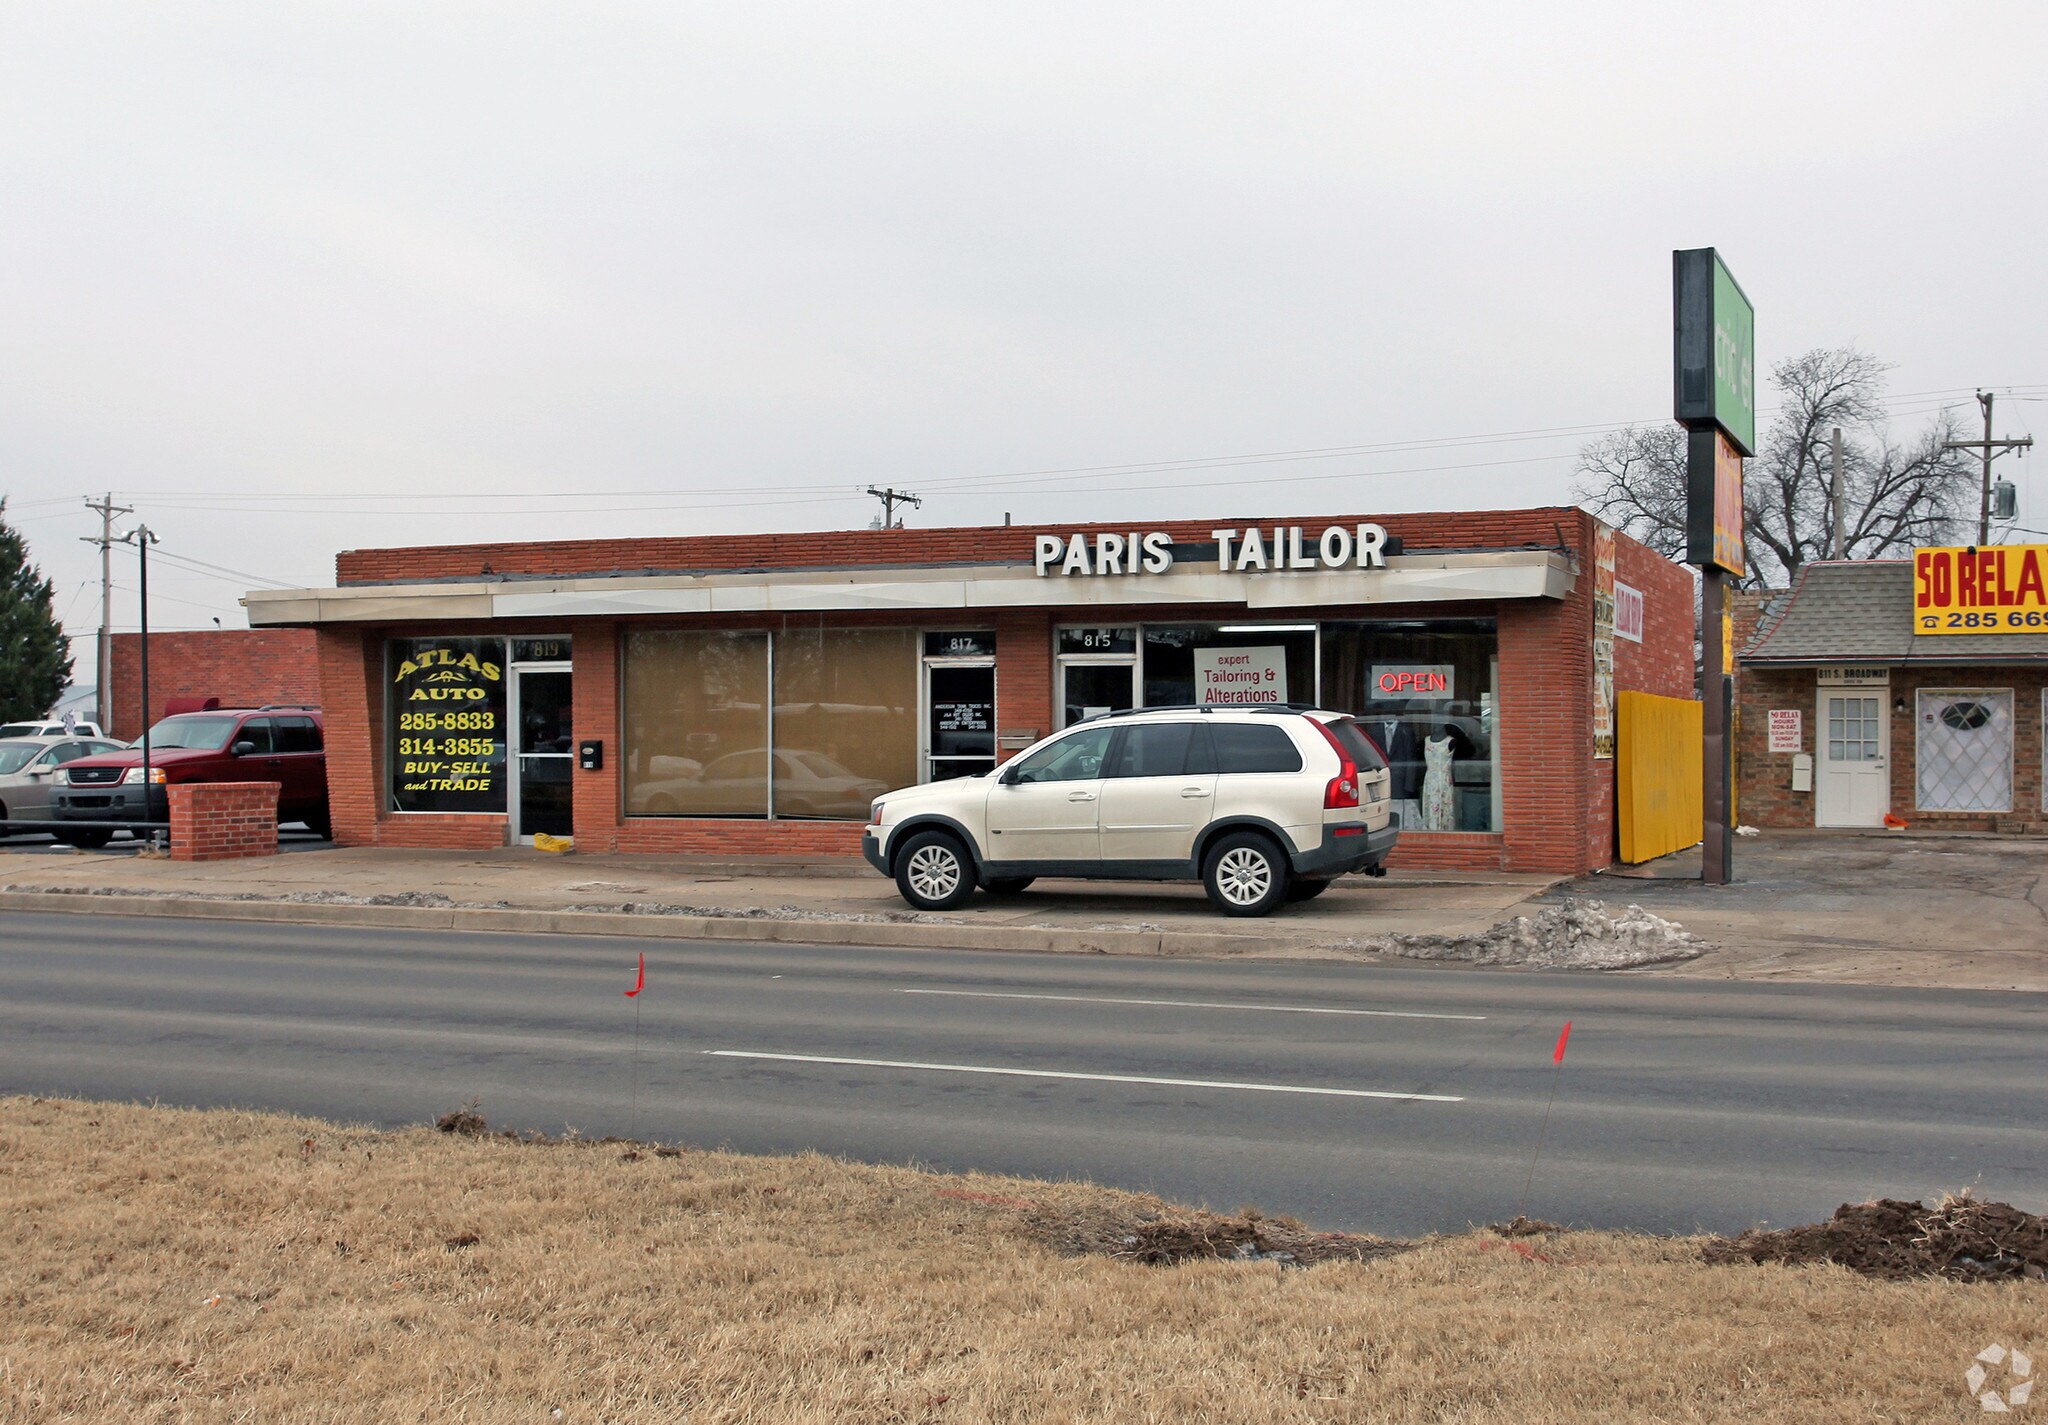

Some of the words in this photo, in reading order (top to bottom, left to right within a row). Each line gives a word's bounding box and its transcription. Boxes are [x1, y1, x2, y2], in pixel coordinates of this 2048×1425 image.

[1036, 532, 1174, 577] PARIS
[1211, 523, 1388, 572] TAILOR
[1917, 552, 1951, 608] SO
[1958, 549, 2048, 607] RELA
[1947, 612, 1998, 628] 285
[2007, 611, 2048, 627] 66
[534, 641, 559, 657] 819
[950, 637, 973, 650] 817
[1084, 634, 1111, 647] 815
[394, 649, 501, 683] ATLAS
[1217, 655, 1250, 667] expert
[1203, 669, 1260, 685] Tailoring
[1264, 668, 1276, 681] &
[1379, 672, 1445, 692] OPEN
[1818, 669, 1832, 679] 811
[1844, 669, 1887, 679] BROADWAY
[408, 687, 486, 701] AUTO
[1204, 687, 1278, 704] Alterations
[400, 712, 495, 730] 285-8833
[400, 737, 495, 756] 314-3855
[404, 761, 492, 774] BUY-SELL
[404, 780, 428, 791] and
[429, 778, 492, 792] TRADE
